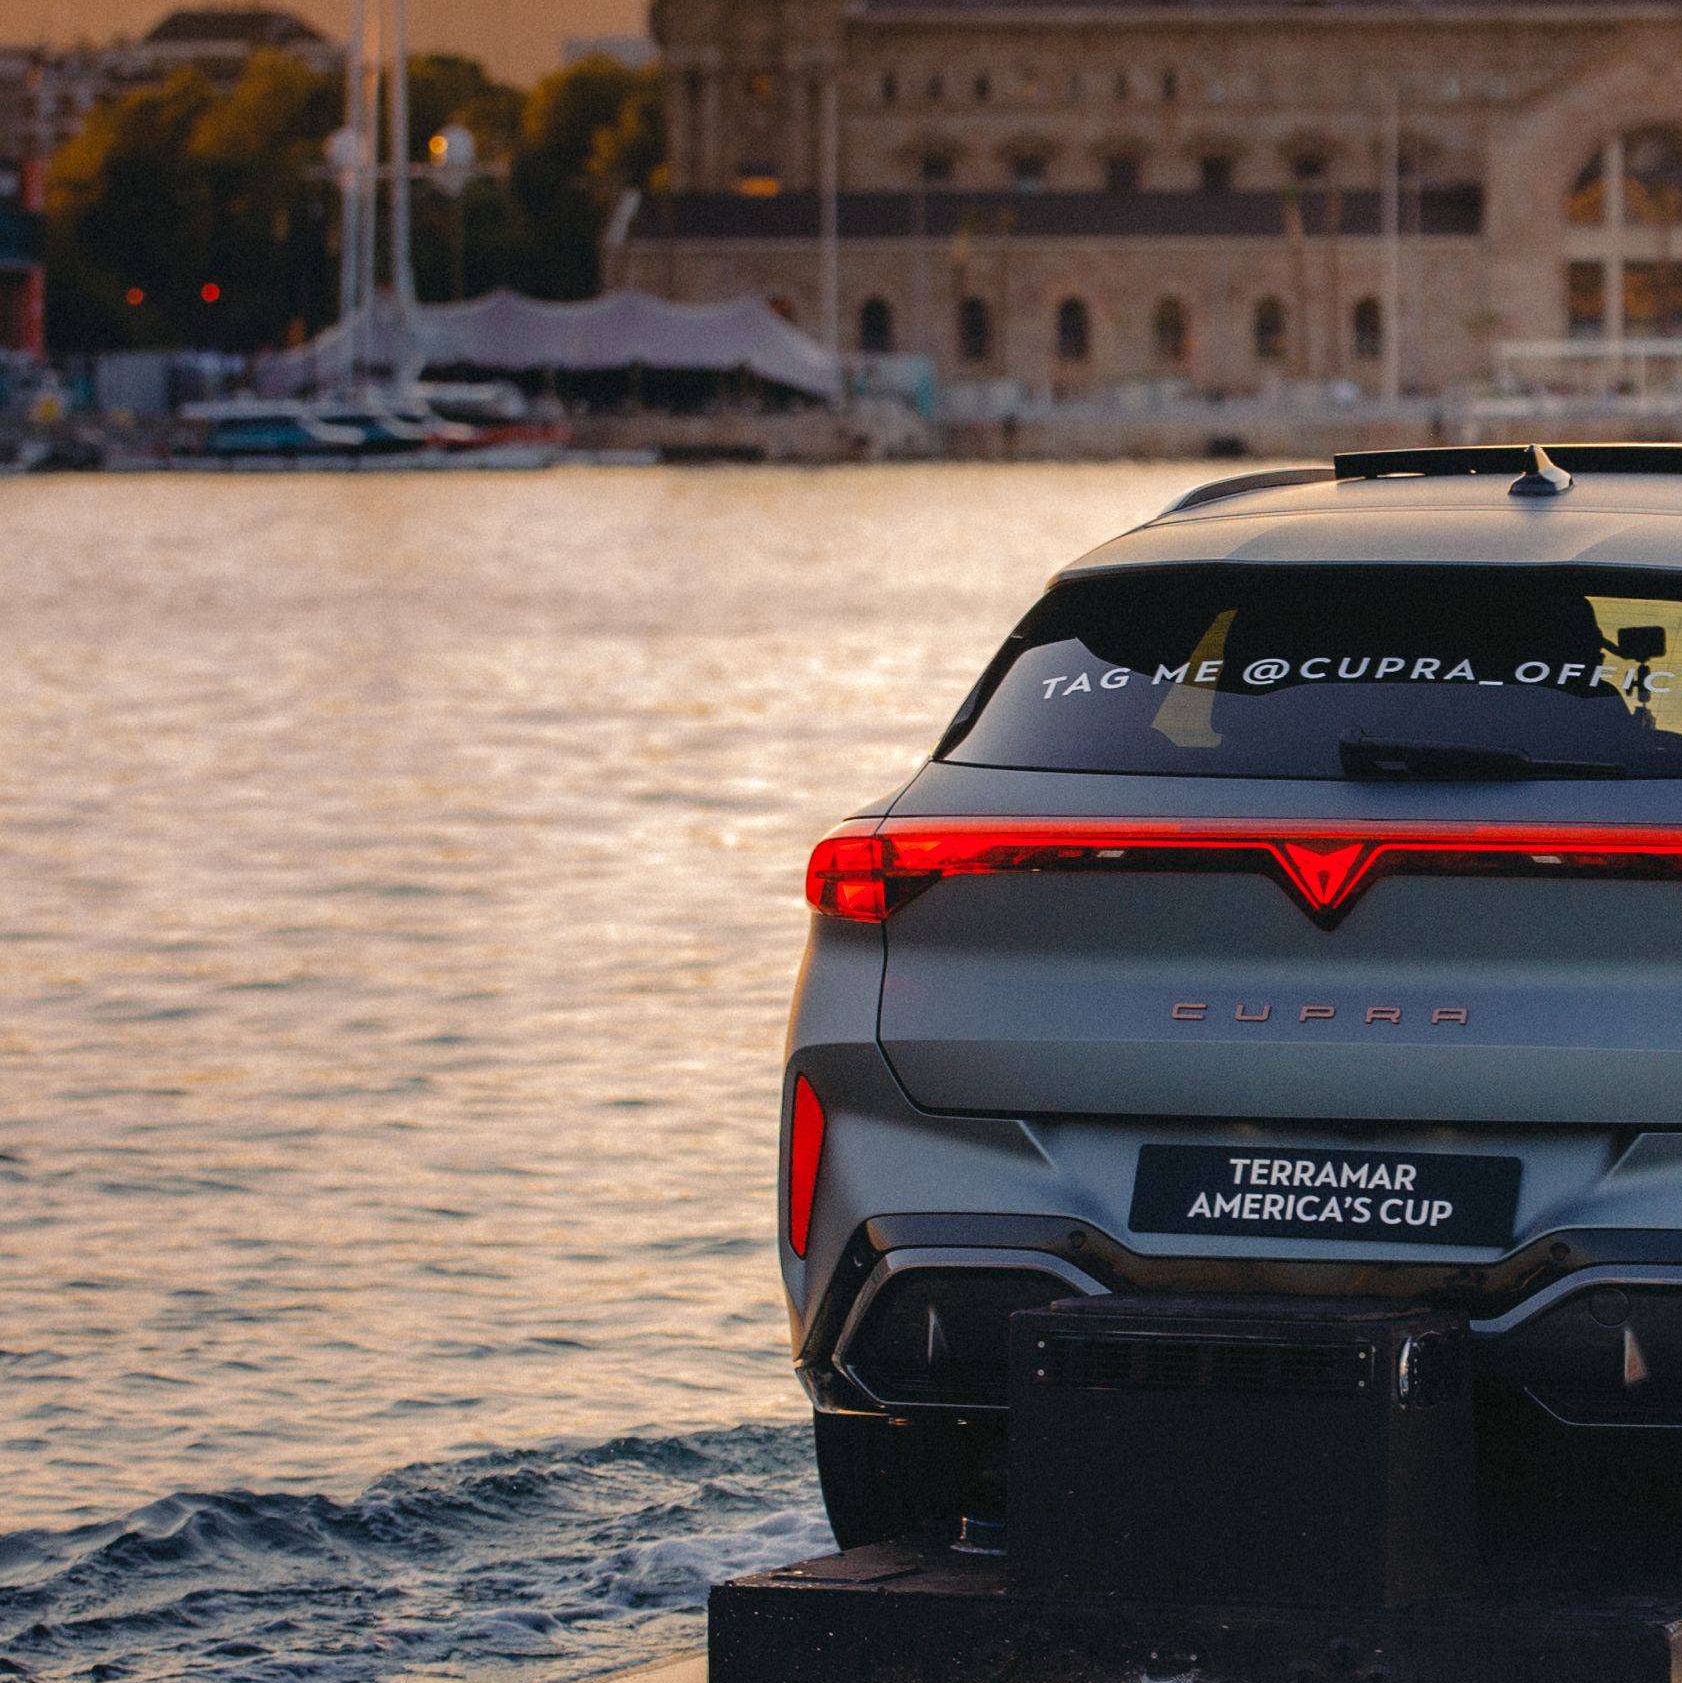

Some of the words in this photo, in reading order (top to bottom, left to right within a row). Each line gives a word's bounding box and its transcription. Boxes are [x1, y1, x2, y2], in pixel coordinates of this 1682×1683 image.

[1041, 667, 1131, 700] TAG
[1151, 660, 1223, 685] ME
[1171, 1002, 1469, 1025] CUPRA
[1229, 1158, 1417, 1191] TERRAMAR
[1187, 1191, 1373, 1223] AMERICA'S
[1379, 1198, 1454, 1227] CUP
